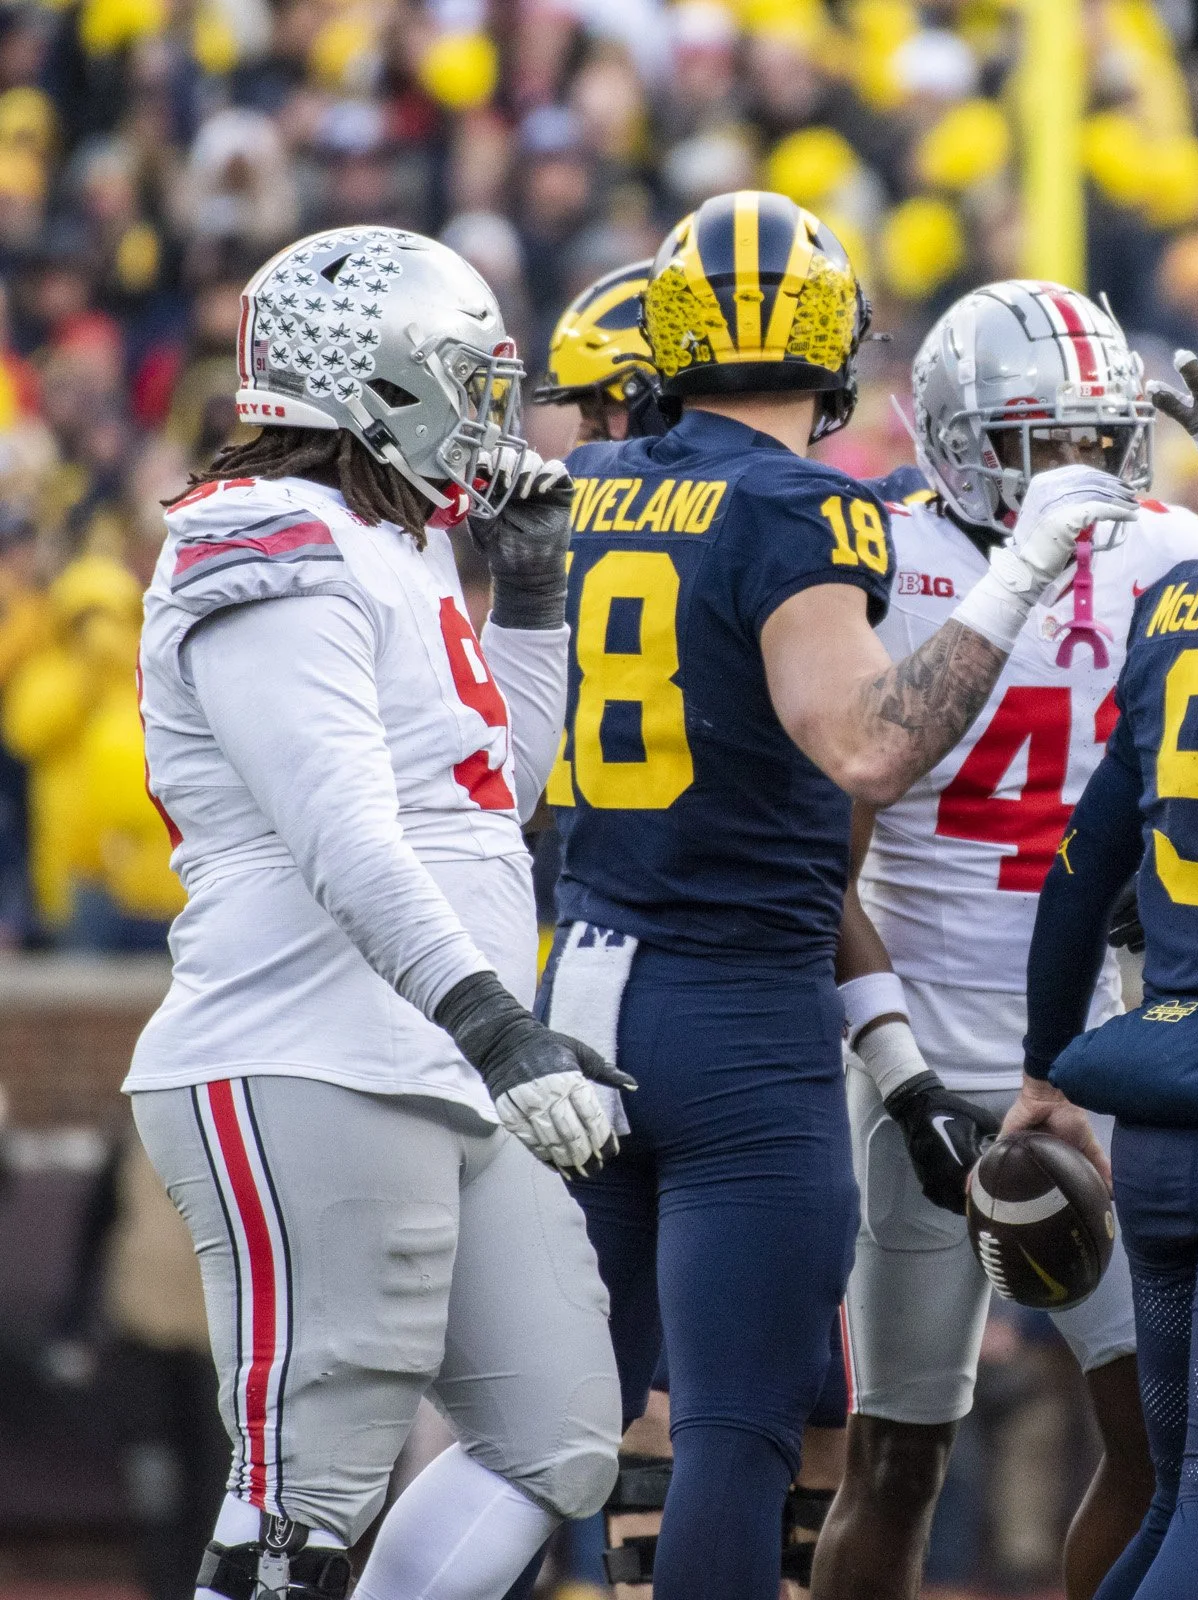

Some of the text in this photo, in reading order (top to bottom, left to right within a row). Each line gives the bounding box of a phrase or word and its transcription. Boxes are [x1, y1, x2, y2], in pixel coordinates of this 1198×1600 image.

[257, 358, 266, 371] 91
[821, 495, 888, 575] 18
[935, 683, 1120, 893] 4
